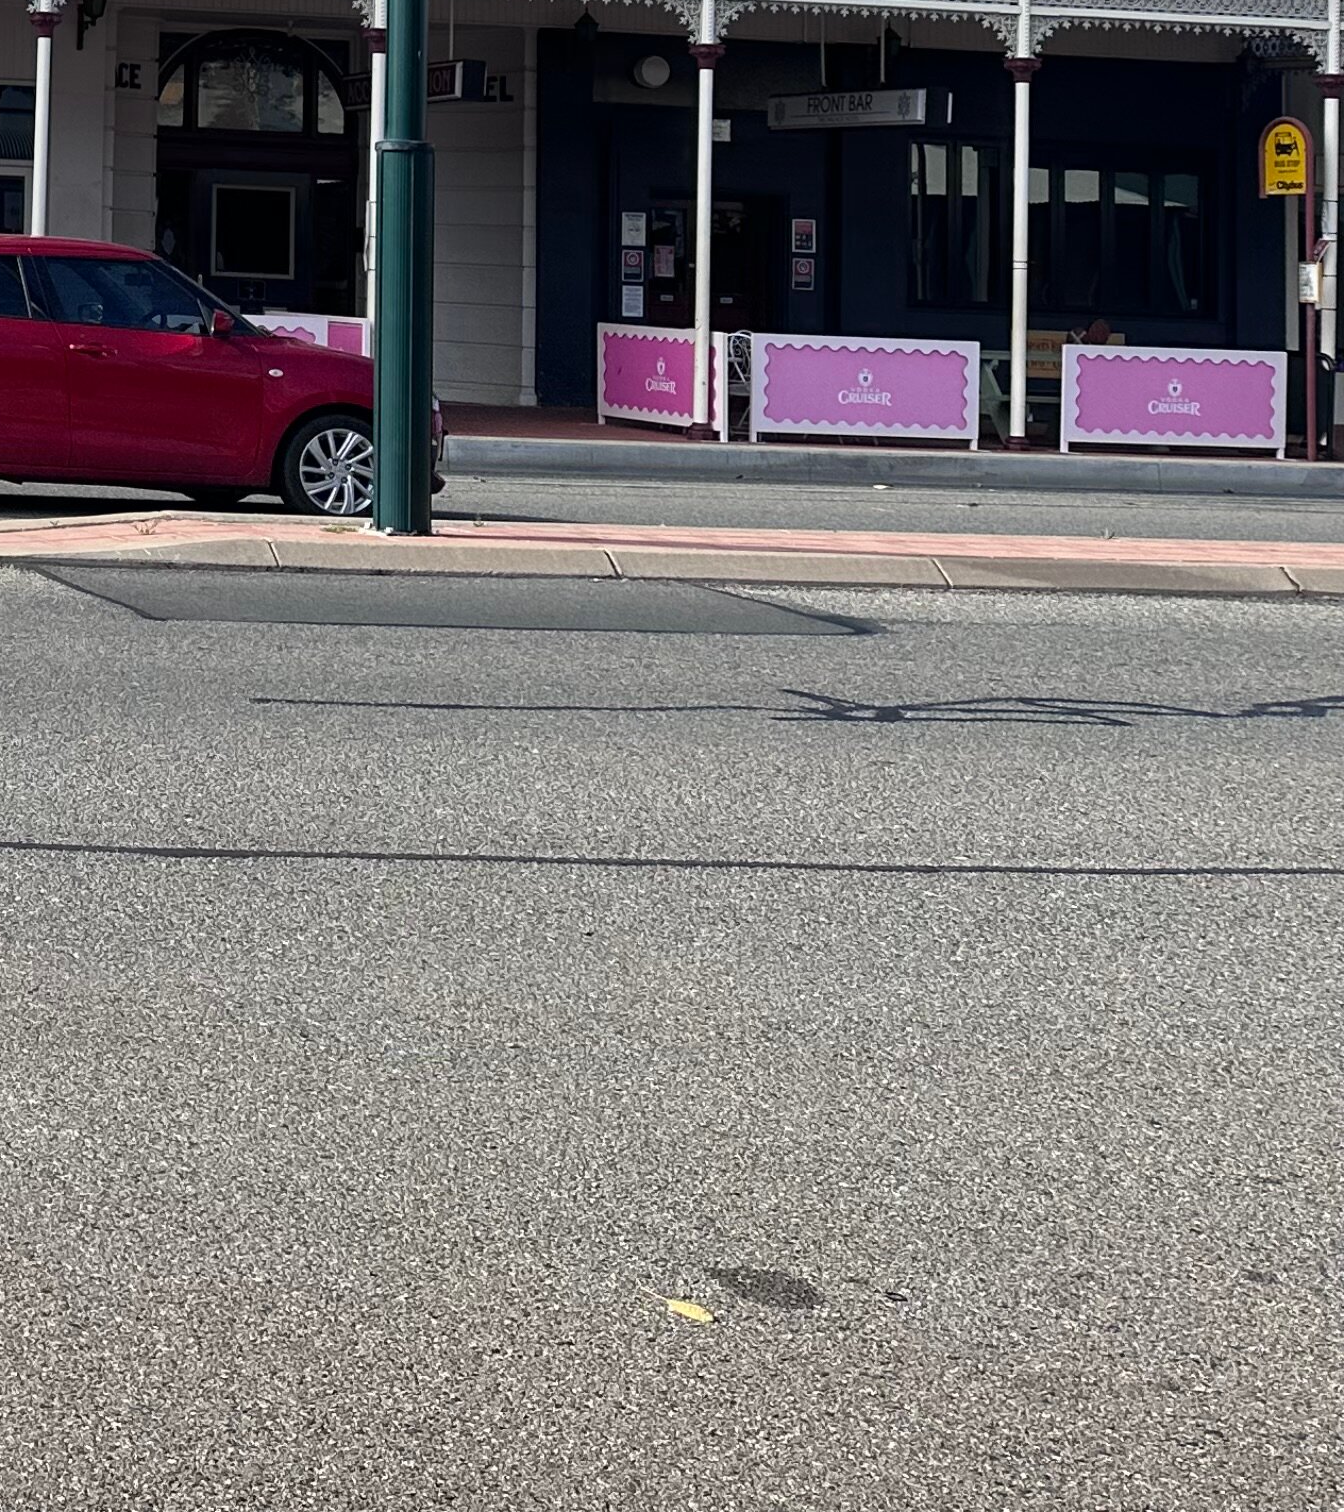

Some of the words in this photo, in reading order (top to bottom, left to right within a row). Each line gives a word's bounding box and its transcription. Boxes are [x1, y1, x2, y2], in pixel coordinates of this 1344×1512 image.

[807, 96, 846, 113] FRONT
[849, 94, 873, 111] BAR
[838, 390, 892, 407] CRUISER
[1148, 400, 1201, 416] CRUISER
